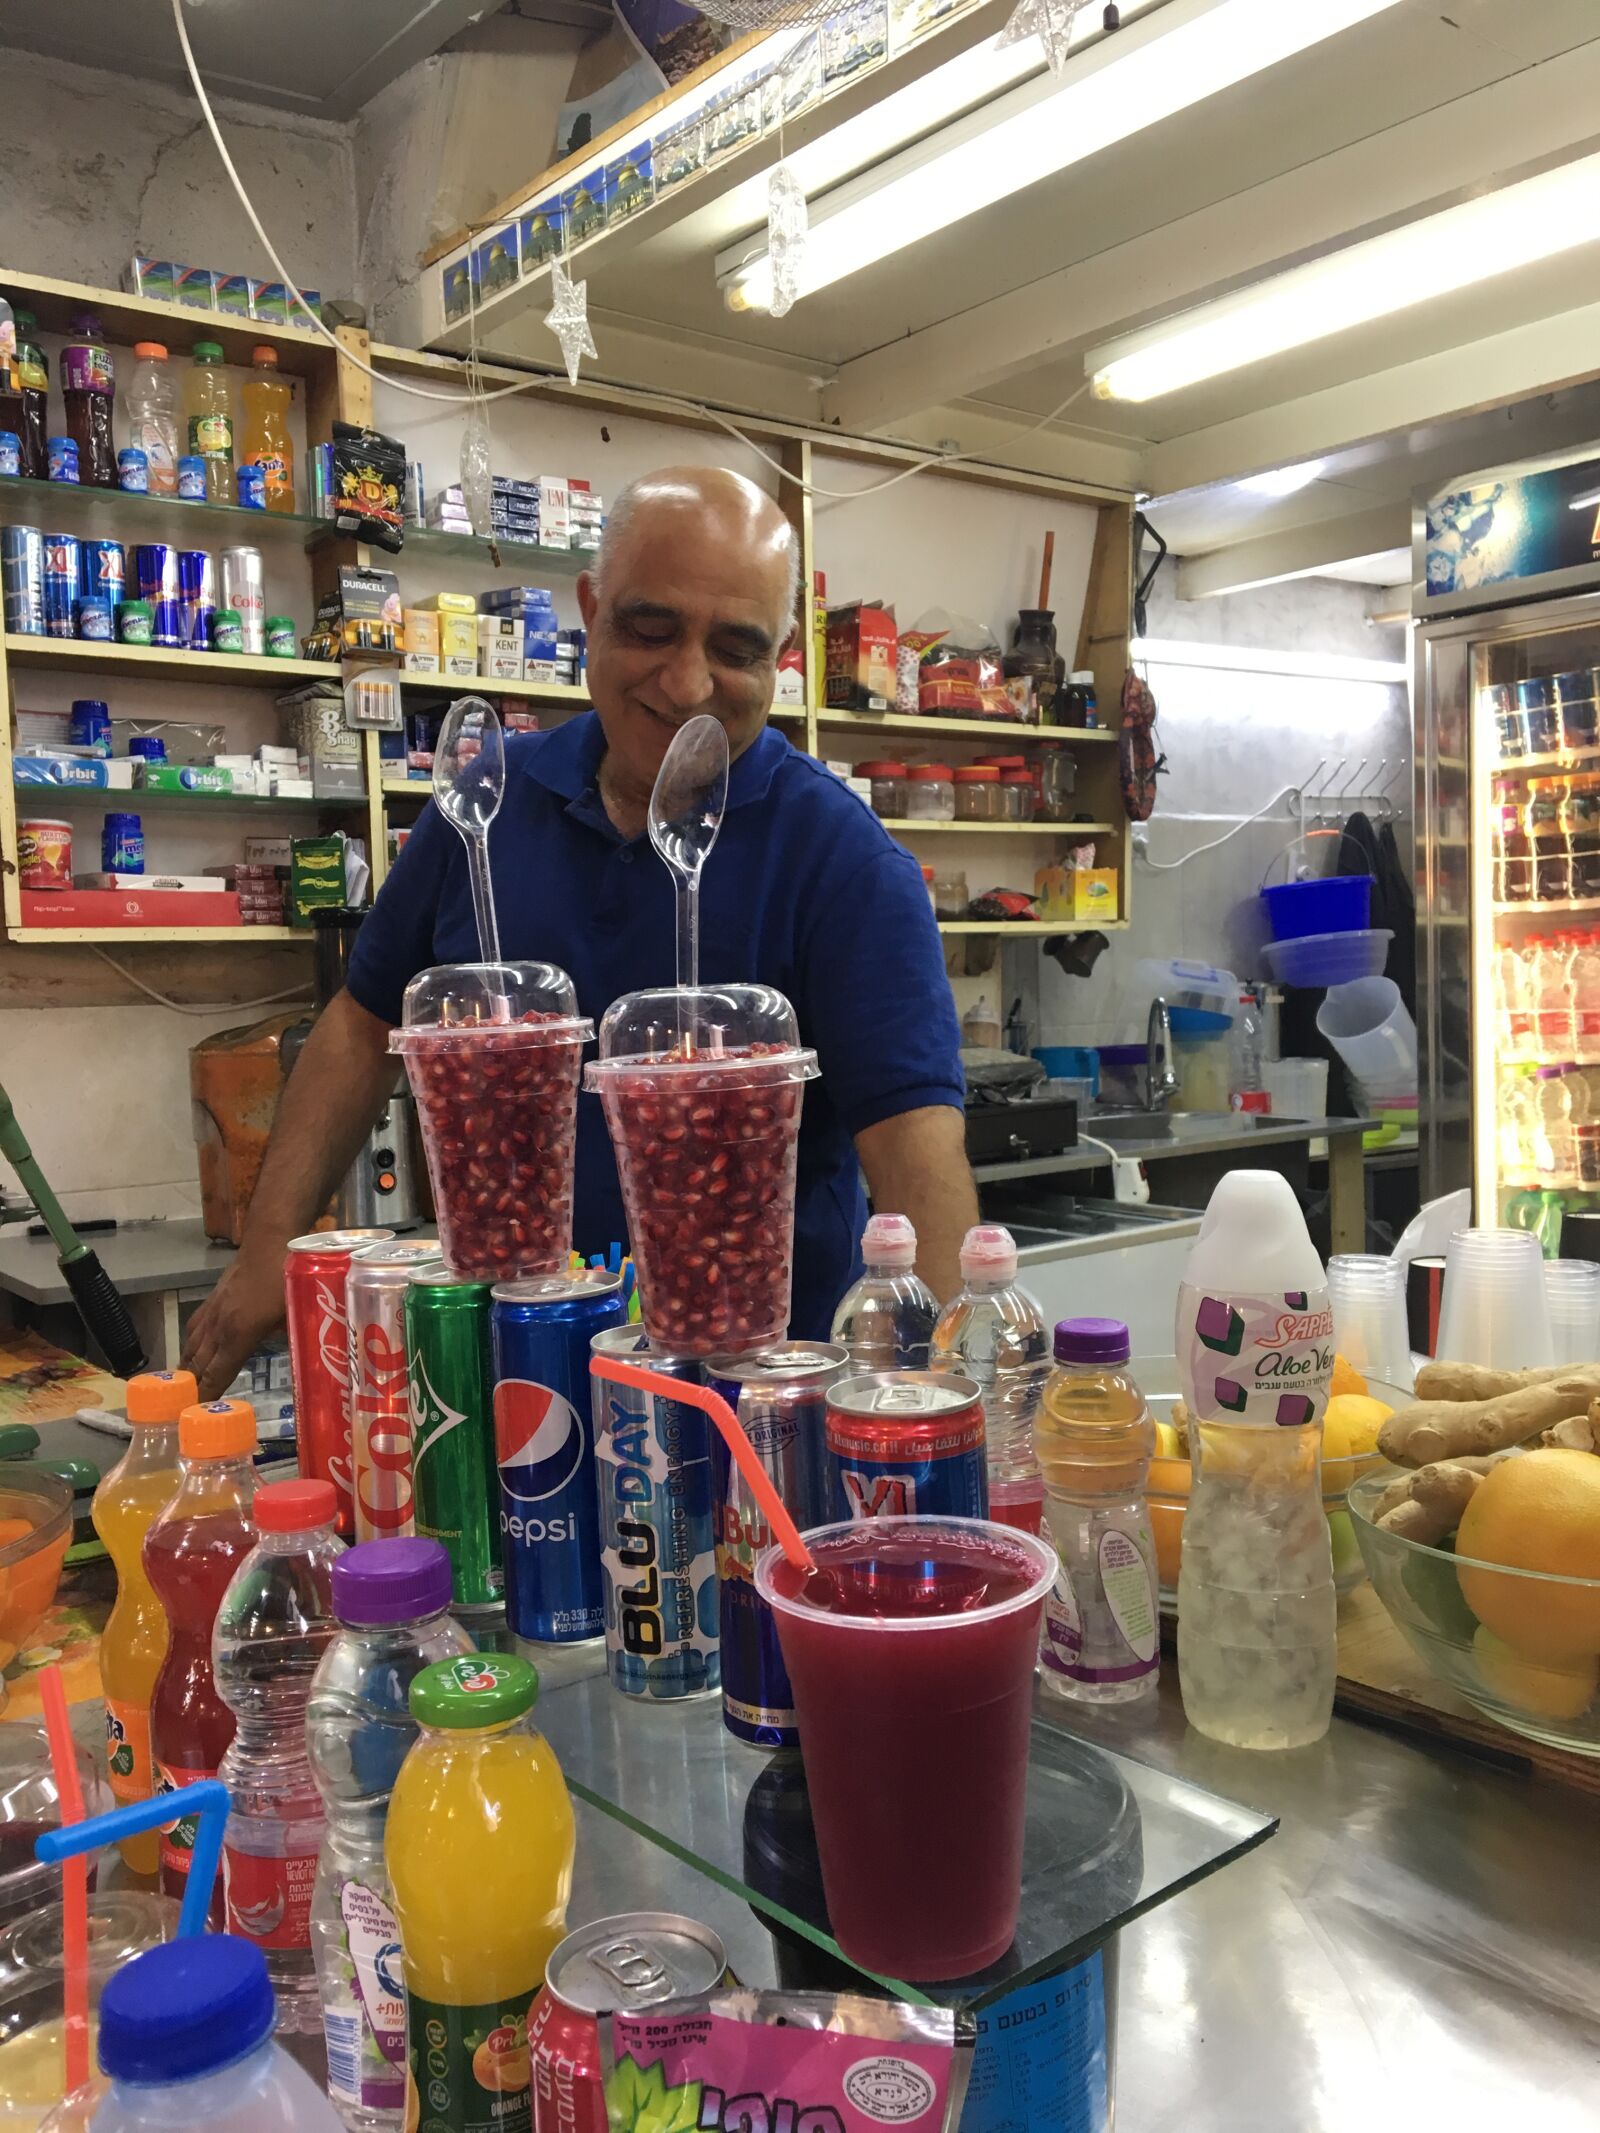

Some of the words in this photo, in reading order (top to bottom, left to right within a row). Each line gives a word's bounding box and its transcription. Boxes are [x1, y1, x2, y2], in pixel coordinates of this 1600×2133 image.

[342, 579, 387, 593] DURACELL
[232, 594, 264, 609] Coke
[496, 640, 519, 652] KENT
[327, 732, 356, 748] Shag
[53, 761, 97, 784] Orbit
[182, 768, 223, 791] Orbit
[1255, 1382, 1281, 1390] ענבים
[355, 1323, 414, 1529] Coke
[609, 1400, 652, 1503] DAY
[663, 1413, 687, 1497] ENERGY
[500, 1512, 576, 1548] pepsi
[671, 1506, 694, 1640] REFRESHING
[616, 1521, 662, 1656] BLU
[571, 1608, 588, 1621] 330
[348, 1892, 373, 1903] משקה
[349, 1903, 369, 1914] בסיס
[369, 1905, 380, 1916] על
[380, 1919, 397, 1929] מים
[997, 2002, 1047, 2031] בטעם
[645, 2025, 669, 2036] 200
[491, 2095, 522, 2117] ORANGE
